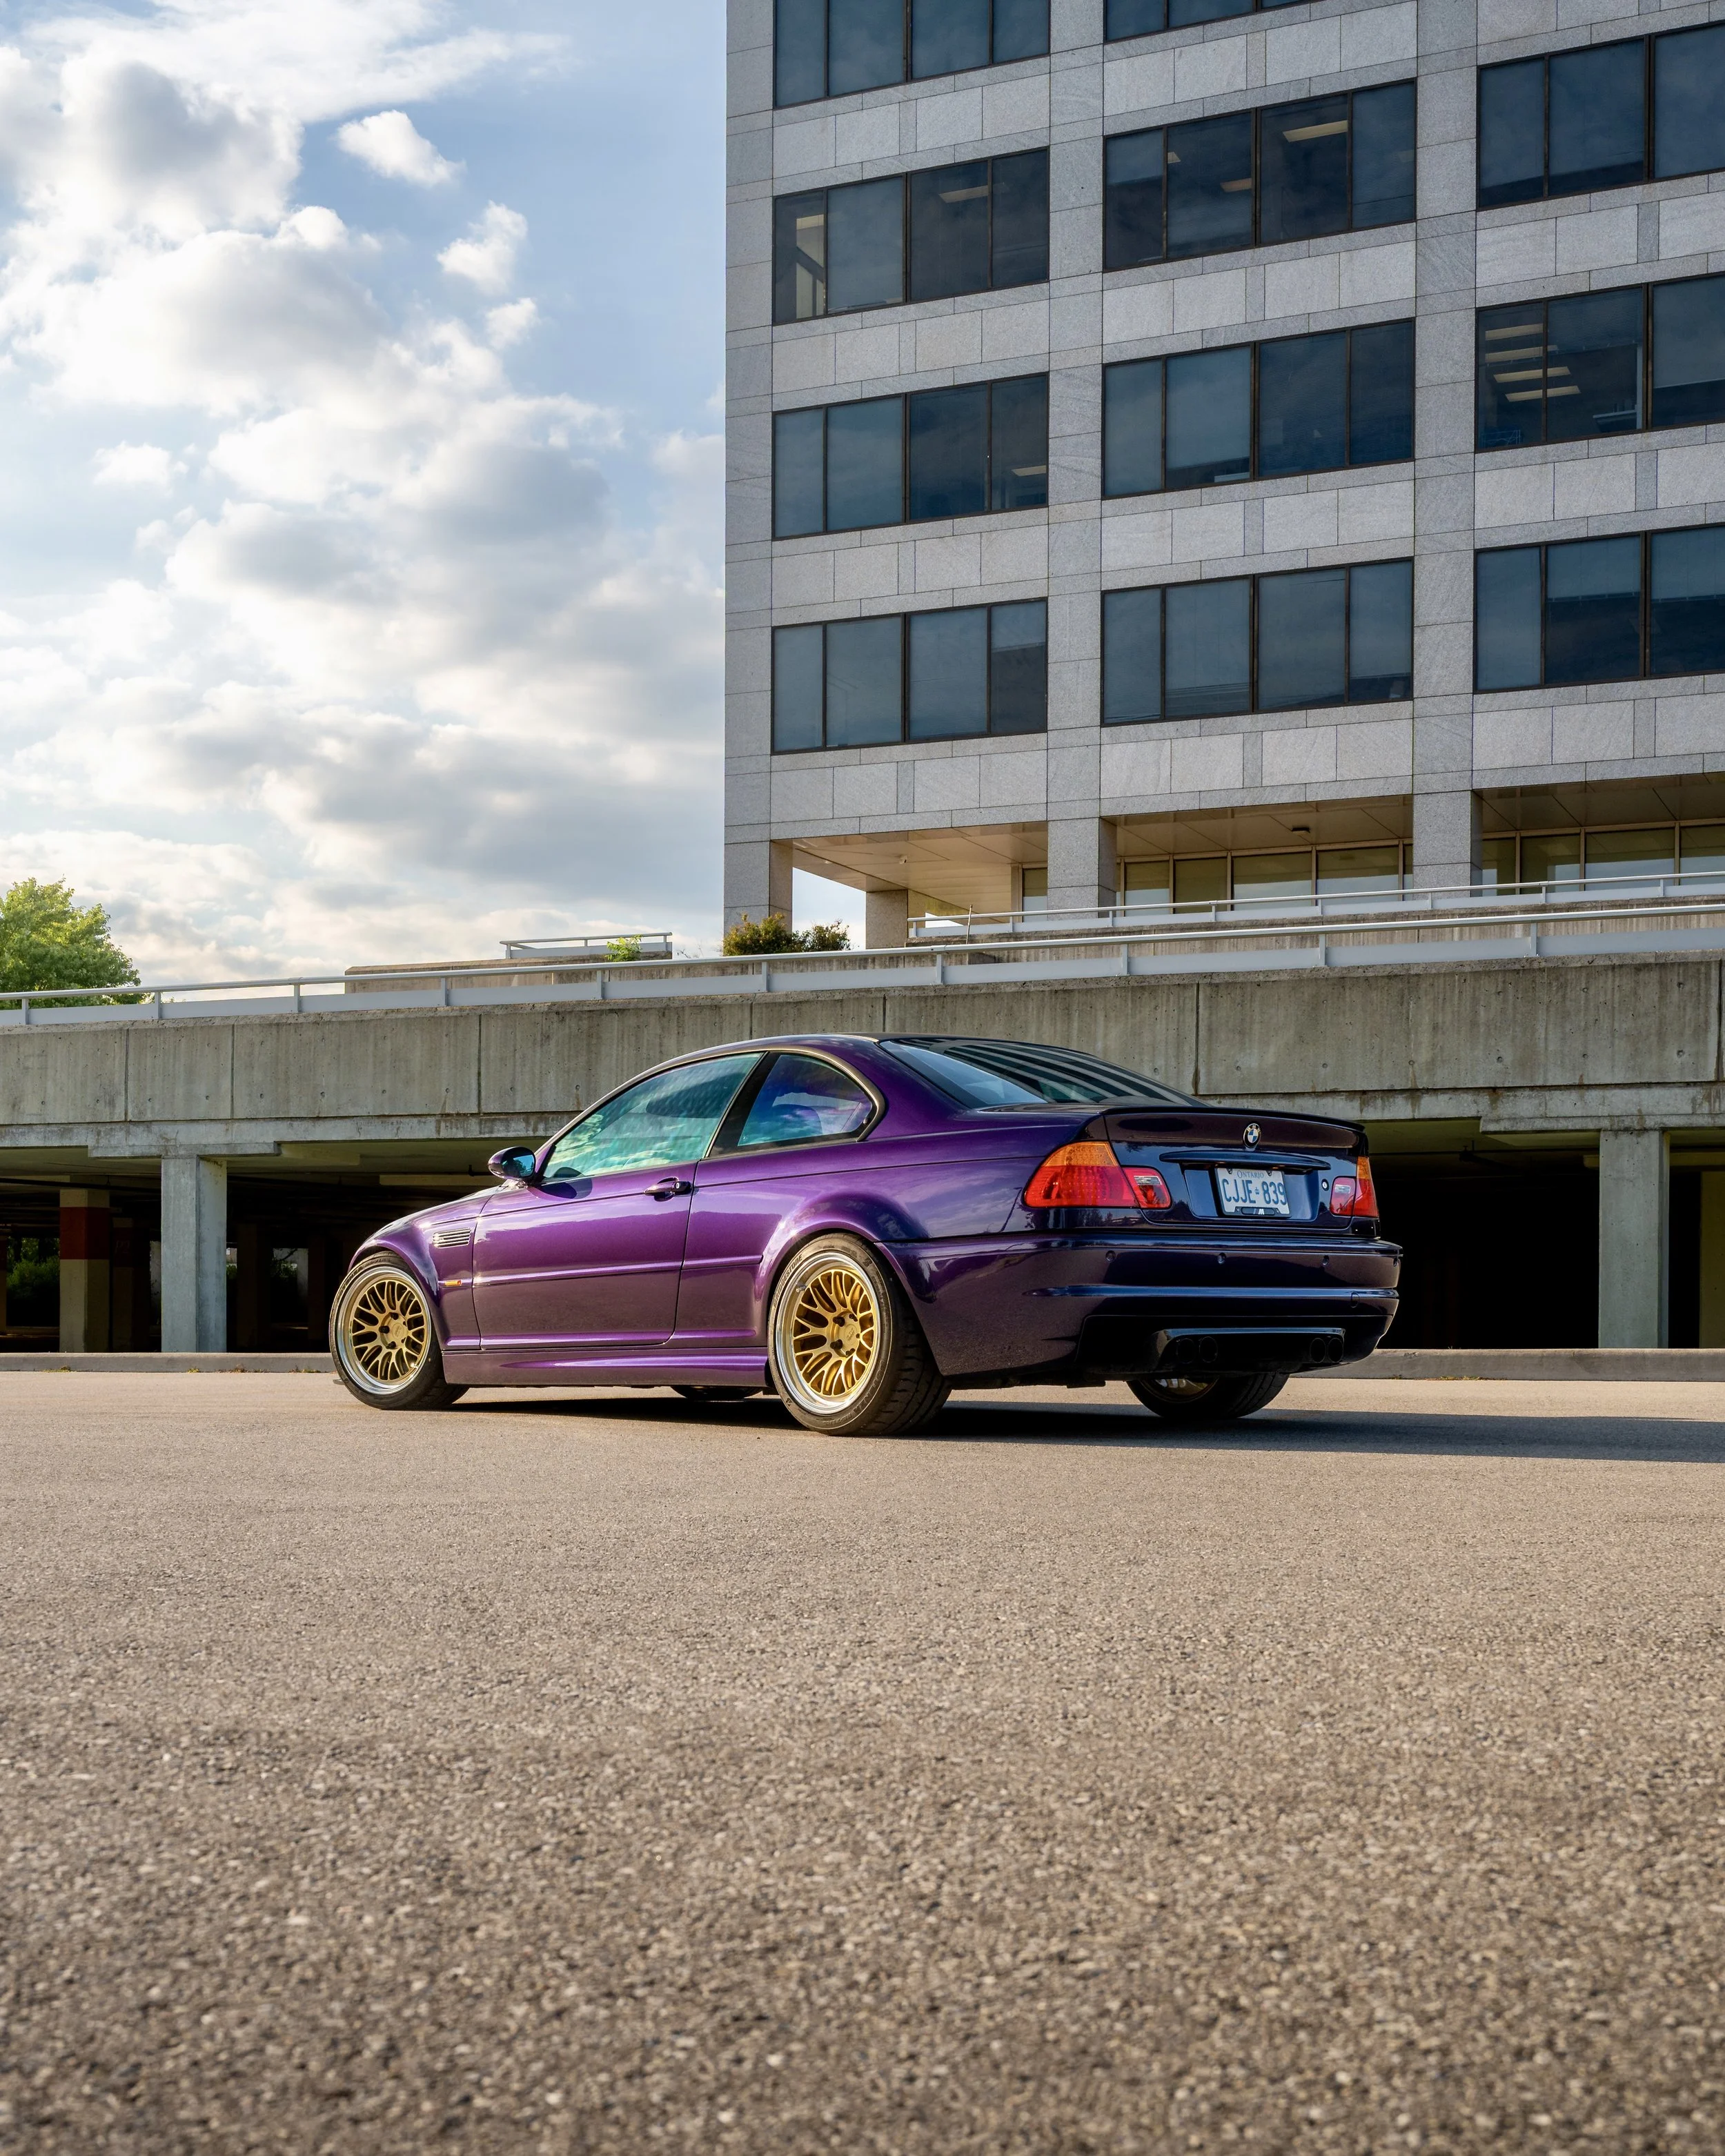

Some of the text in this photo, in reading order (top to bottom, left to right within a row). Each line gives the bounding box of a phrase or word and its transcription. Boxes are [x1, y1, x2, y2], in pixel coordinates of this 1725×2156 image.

[1237, 1170, 1264, 1178] ONTARIO
[1222, 1178, 1287, 1205] CJJE 839
[773, 1254, 802, 1307] BRIDGESTONE
